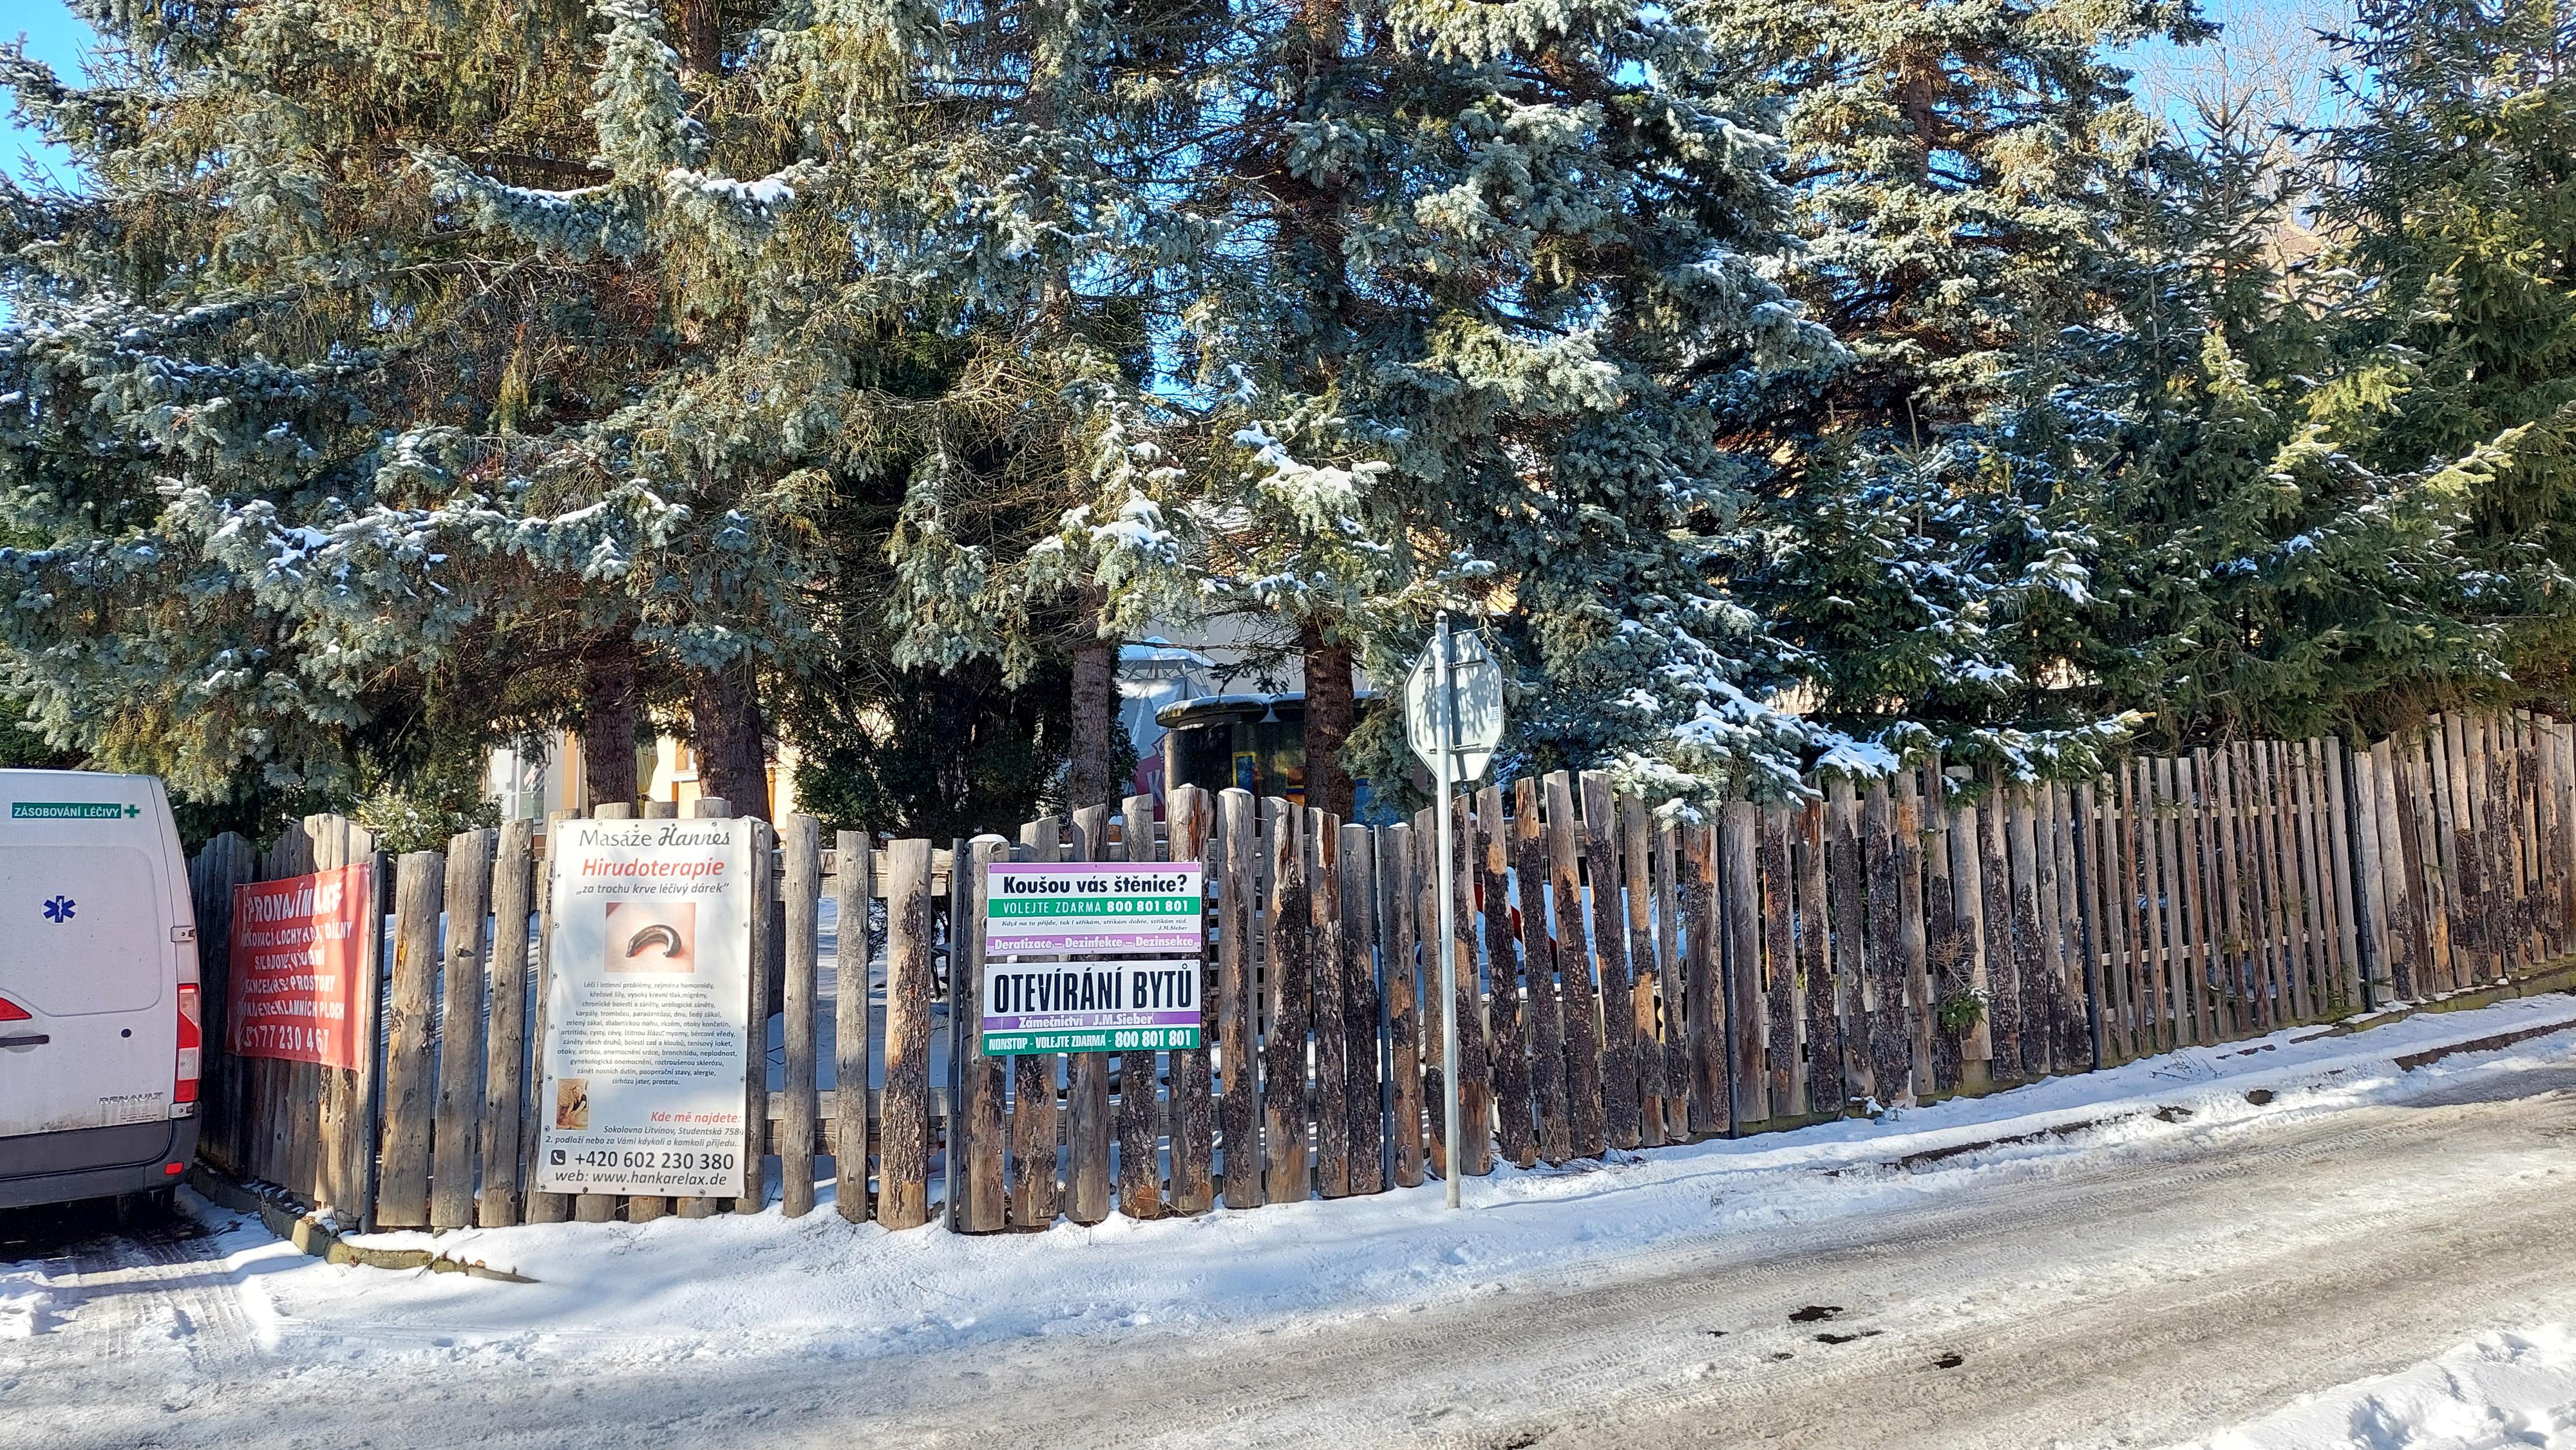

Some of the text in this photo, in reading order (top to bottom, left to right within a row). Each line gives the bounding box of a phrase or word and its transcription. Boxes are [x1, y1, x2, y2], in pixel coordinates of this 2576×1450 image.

[14, 805, 119, 817] ZÁSOBOVÁNÍ LÉČIVY
[579, 827, 730, 846] Masáže Hannes
[582, 858, 724, 880] Hirudoterapie
[597, 883, 629, 893] trochu
[632, 883, 656, 894] krve
[659, 883, 688, 896] léčivý
[1003, 874, 1188, 894] Koušou vás štěnice?
[1003, 900, 1188, 914] VOLEJTE ZDARMA 800 801 801
[325, 918, 352, 939] DÍLNY
[994, 937, 1052, 950] Deratizace
[1065, 936, 1124, 949] Dezinfekce
[1135, 935, 1194, 948] Dezinsekce
[290, 975, 336, 992] PROSTORY
[994, 963, 1191, 1013] OTEVÍRÁNÍ BYTŮ
[319, 1001, 345, 1020] PLOCH
[1018, 1012, 1153, 1029] Zámečnictví J.M.Sieber
[279, 1025, 301, 1051] 230
[307, 1028, 329, 1055] 467
[989, 1037, 1028, 1051] NONSTOP
[1036, 1035, 1070, 1049] VOLEJTE
[1072, 1034, 1106, 1047] ZDARMA
[1115, 1031, 1139, 1048] 800
[1142, 1030, 1164, 1047] 801
[1169, 1030, 1190, 1046] 801
[99, 1092, 164, 1104] RENAULT
[651, 1111, 741, 1125] Kde mě najdete:
[603, 1125, 643, 1134] Sokolovna
[645, 1126, 676, 1135] Litvínov,
[678, 1127, 722, 1135] Studentská
[554, 1136, 584, 1144] podlaží
[638, 1137, 665, 1146] kdykoli
[574, 1151, 734, 1170] +420 602 230 380
[556, 1169, 726, 1185] web: www.hankarelax.de
